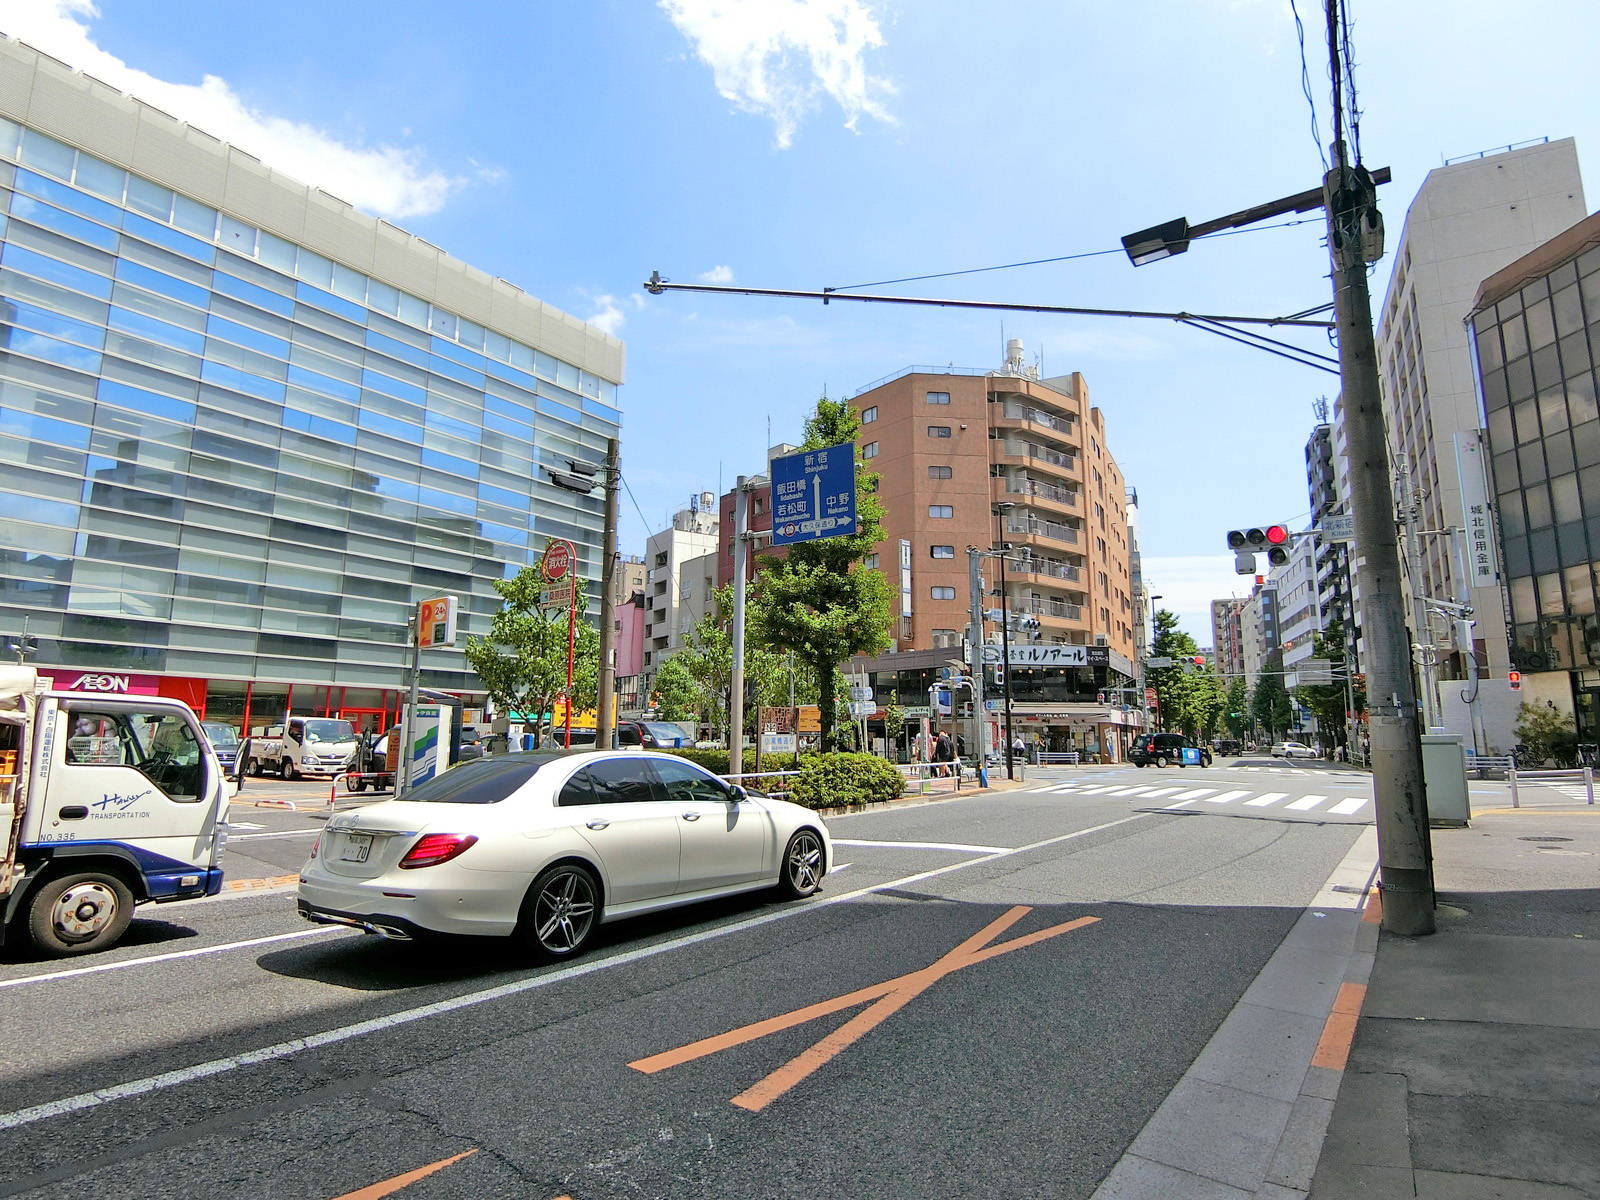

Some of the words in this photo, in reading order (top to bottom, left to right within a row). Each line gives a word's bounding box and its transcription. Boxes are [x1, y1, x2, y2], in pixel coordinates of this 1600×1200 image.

[805, 451, 828, 466] 新宿
[805, 464, 828, 474] Shinjuku
[777, 479, 807, 495] 飯田橋
[826, 492, 849, 507] 中野
[777, 500, 807, 516] 若松町
[827, 506, 849, 515] Nakano
[775, 512, 810, 523] Wakamatsucho
[802, 519, 834, 531] 大久保通り
[1470, 505, 1491, 576] 城北信用金庫
[549, 554, 568, 569] 消火栓
[421, 604, 432, 632] P
[90, 811, 151, 820] TRANSPORTATION
